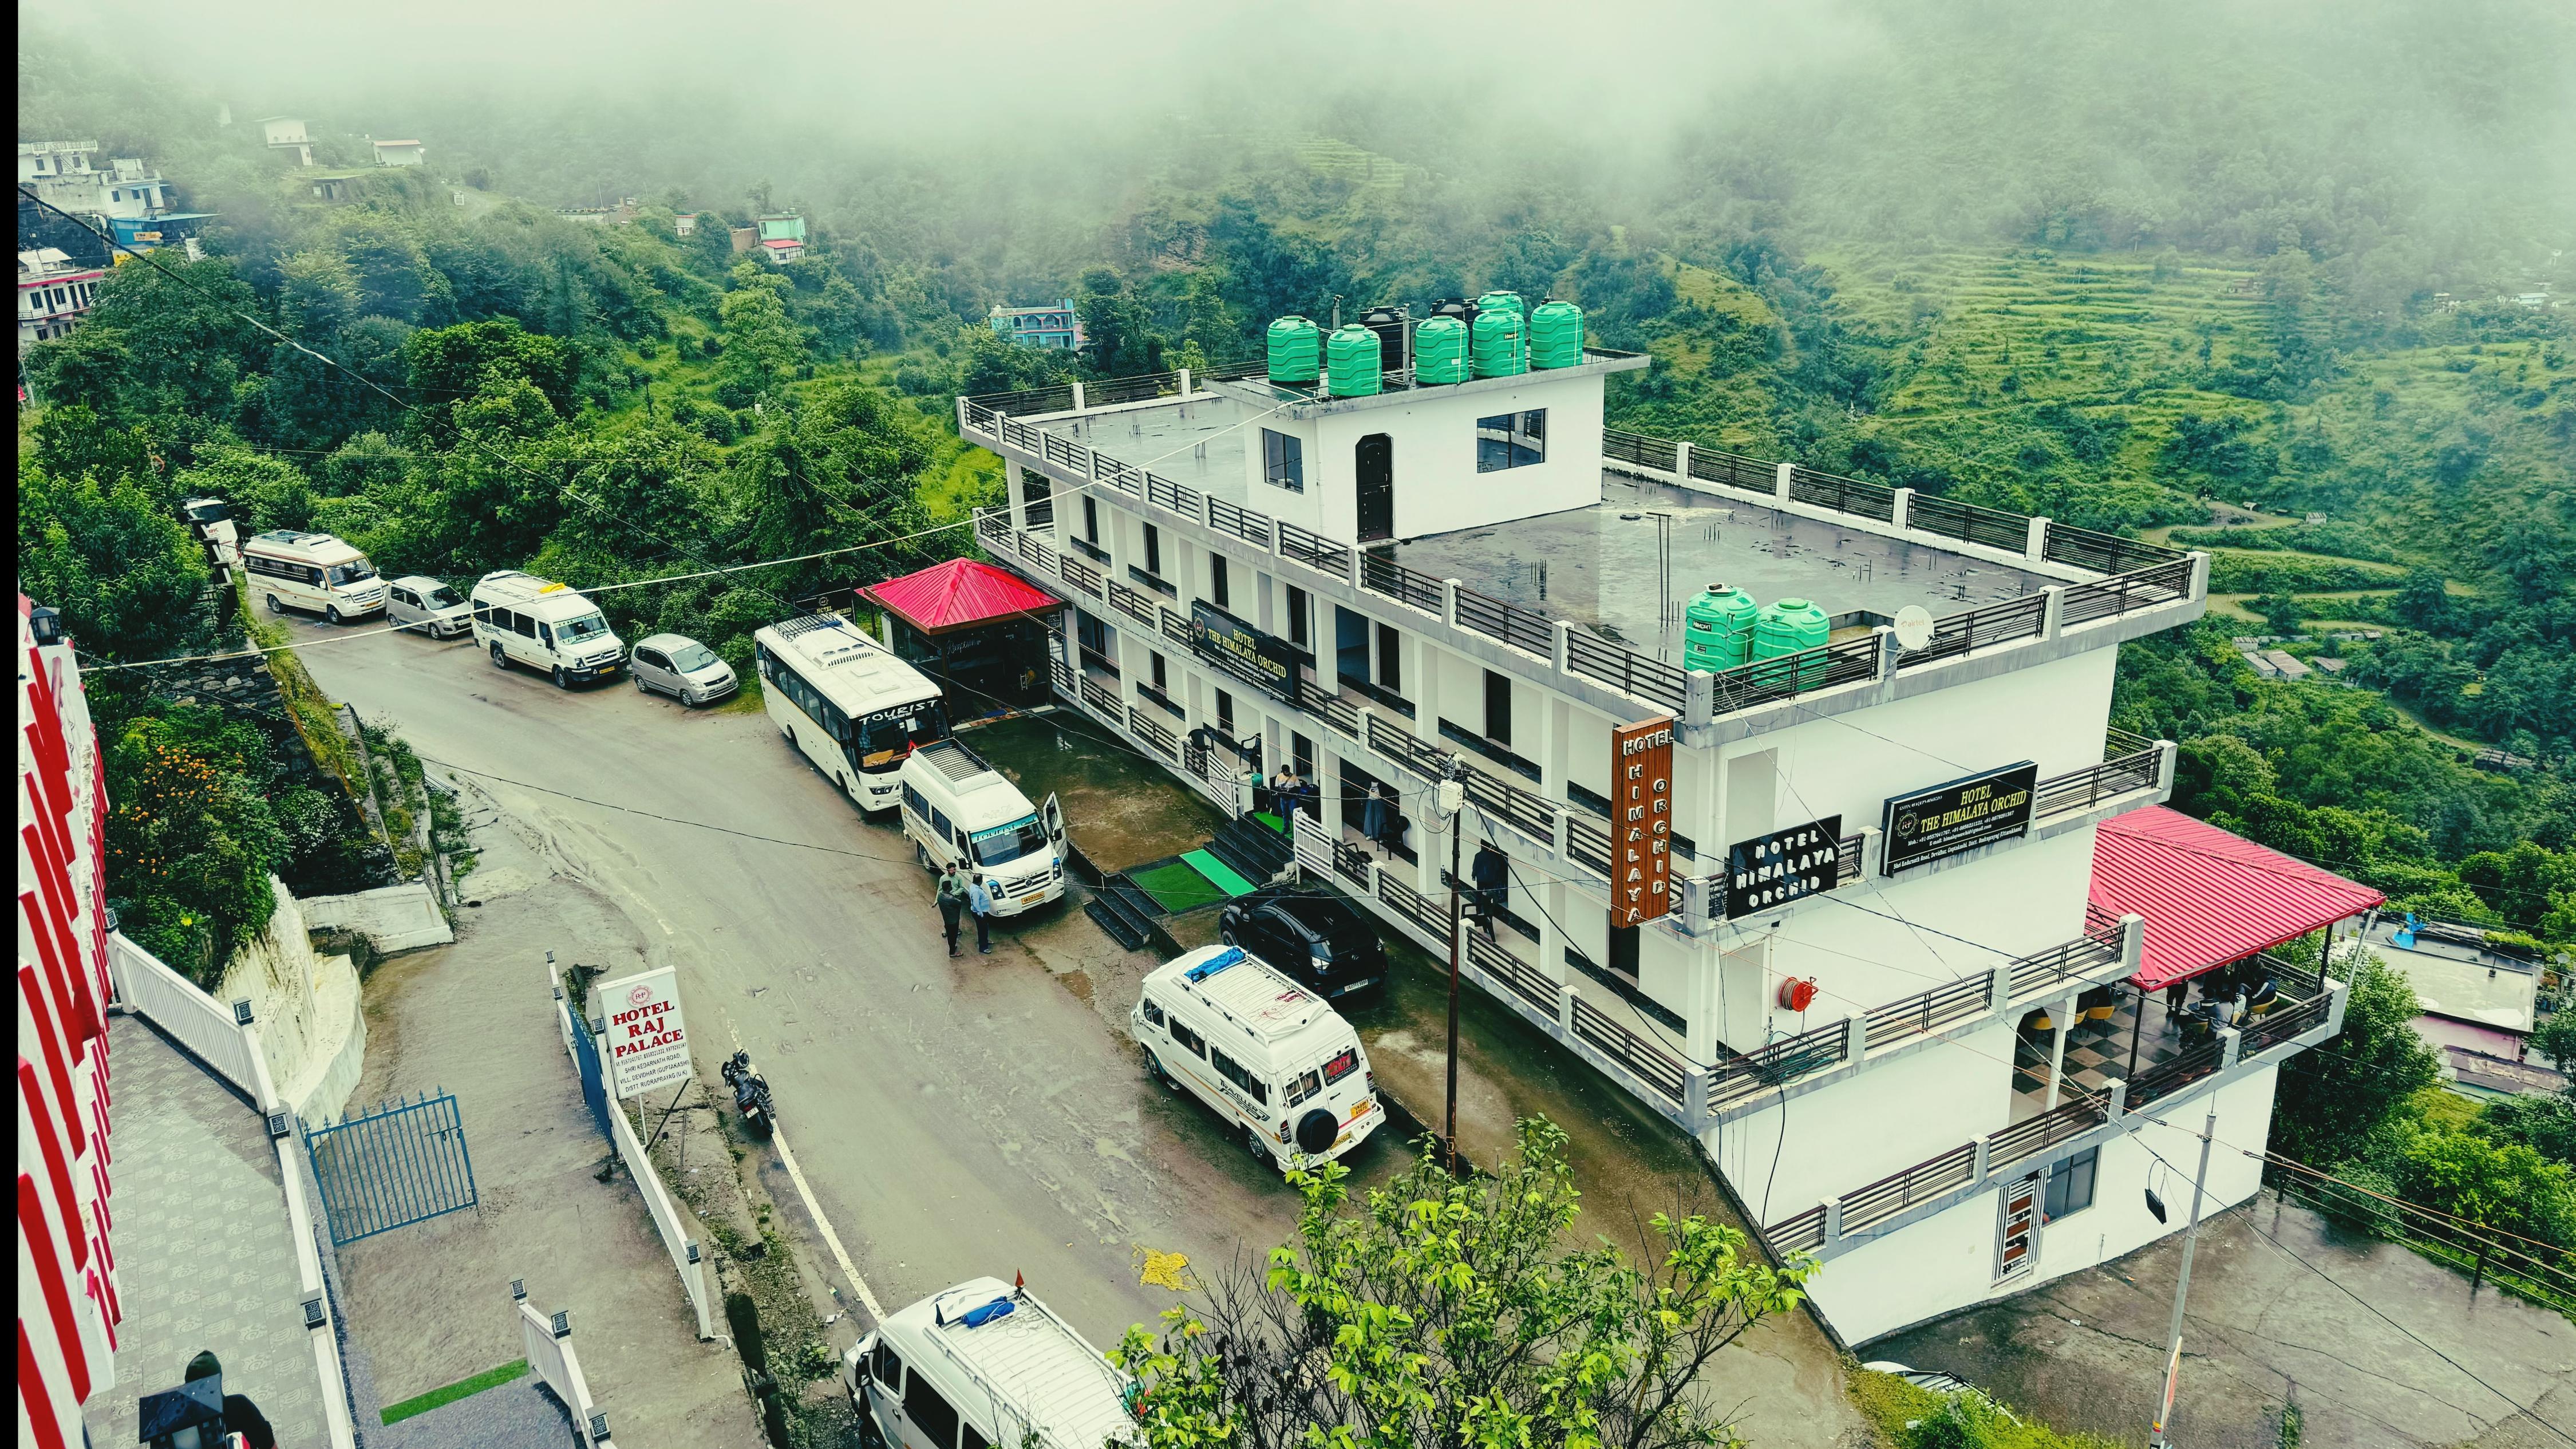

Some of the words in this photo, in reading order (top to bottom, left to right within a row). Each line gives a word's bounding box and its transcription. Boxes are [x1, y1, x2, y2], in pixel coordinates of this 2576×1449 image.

[1207, 628, 1221, 645] THE
[1222, 637, 1257, 664] HIMALAYA
[1258, 655, 1287, 678] ORCHID
[1232, 629, 1257, 650] HOTEL
[859, 700, 938, 725] TOURIST
[1623, 728, 1674, 756] HOTEL
[1961, 784, 1992, 806] HOTEL
[1921, 815, 1940, 834] THE
[1941, 802, 1989, 828] HIMALAYA
[1991, 790, 2027, 813] ORCHID
[976, 823, 1015, 841] TOURIST
[1627, 763, 1645, 923] HIMALAYA
[1652, 777, 1668, 895] ORCHID
[1755, 830, 1819, 859] HOTEL
[1736, 847, 1835, 890] HIMALAYA
[1749, 876, 1820, 907] ORCHID
[612, 1000, 675, 1026] HOTEL
[627, 1017, 665, 1039] RAJ
[615, 1029, 683, 1058] PALACE
[625, 1065, 637, 1073] SHRI
[637, 1057, 666, 1070] KEDARNATH
[632, 1069, 657, 1081] DEVIDHAR
[641, 1073, 676, 1088] RUDRAPRAYAG
[1219, 1079, 1258, 1111] TRAVELLER
